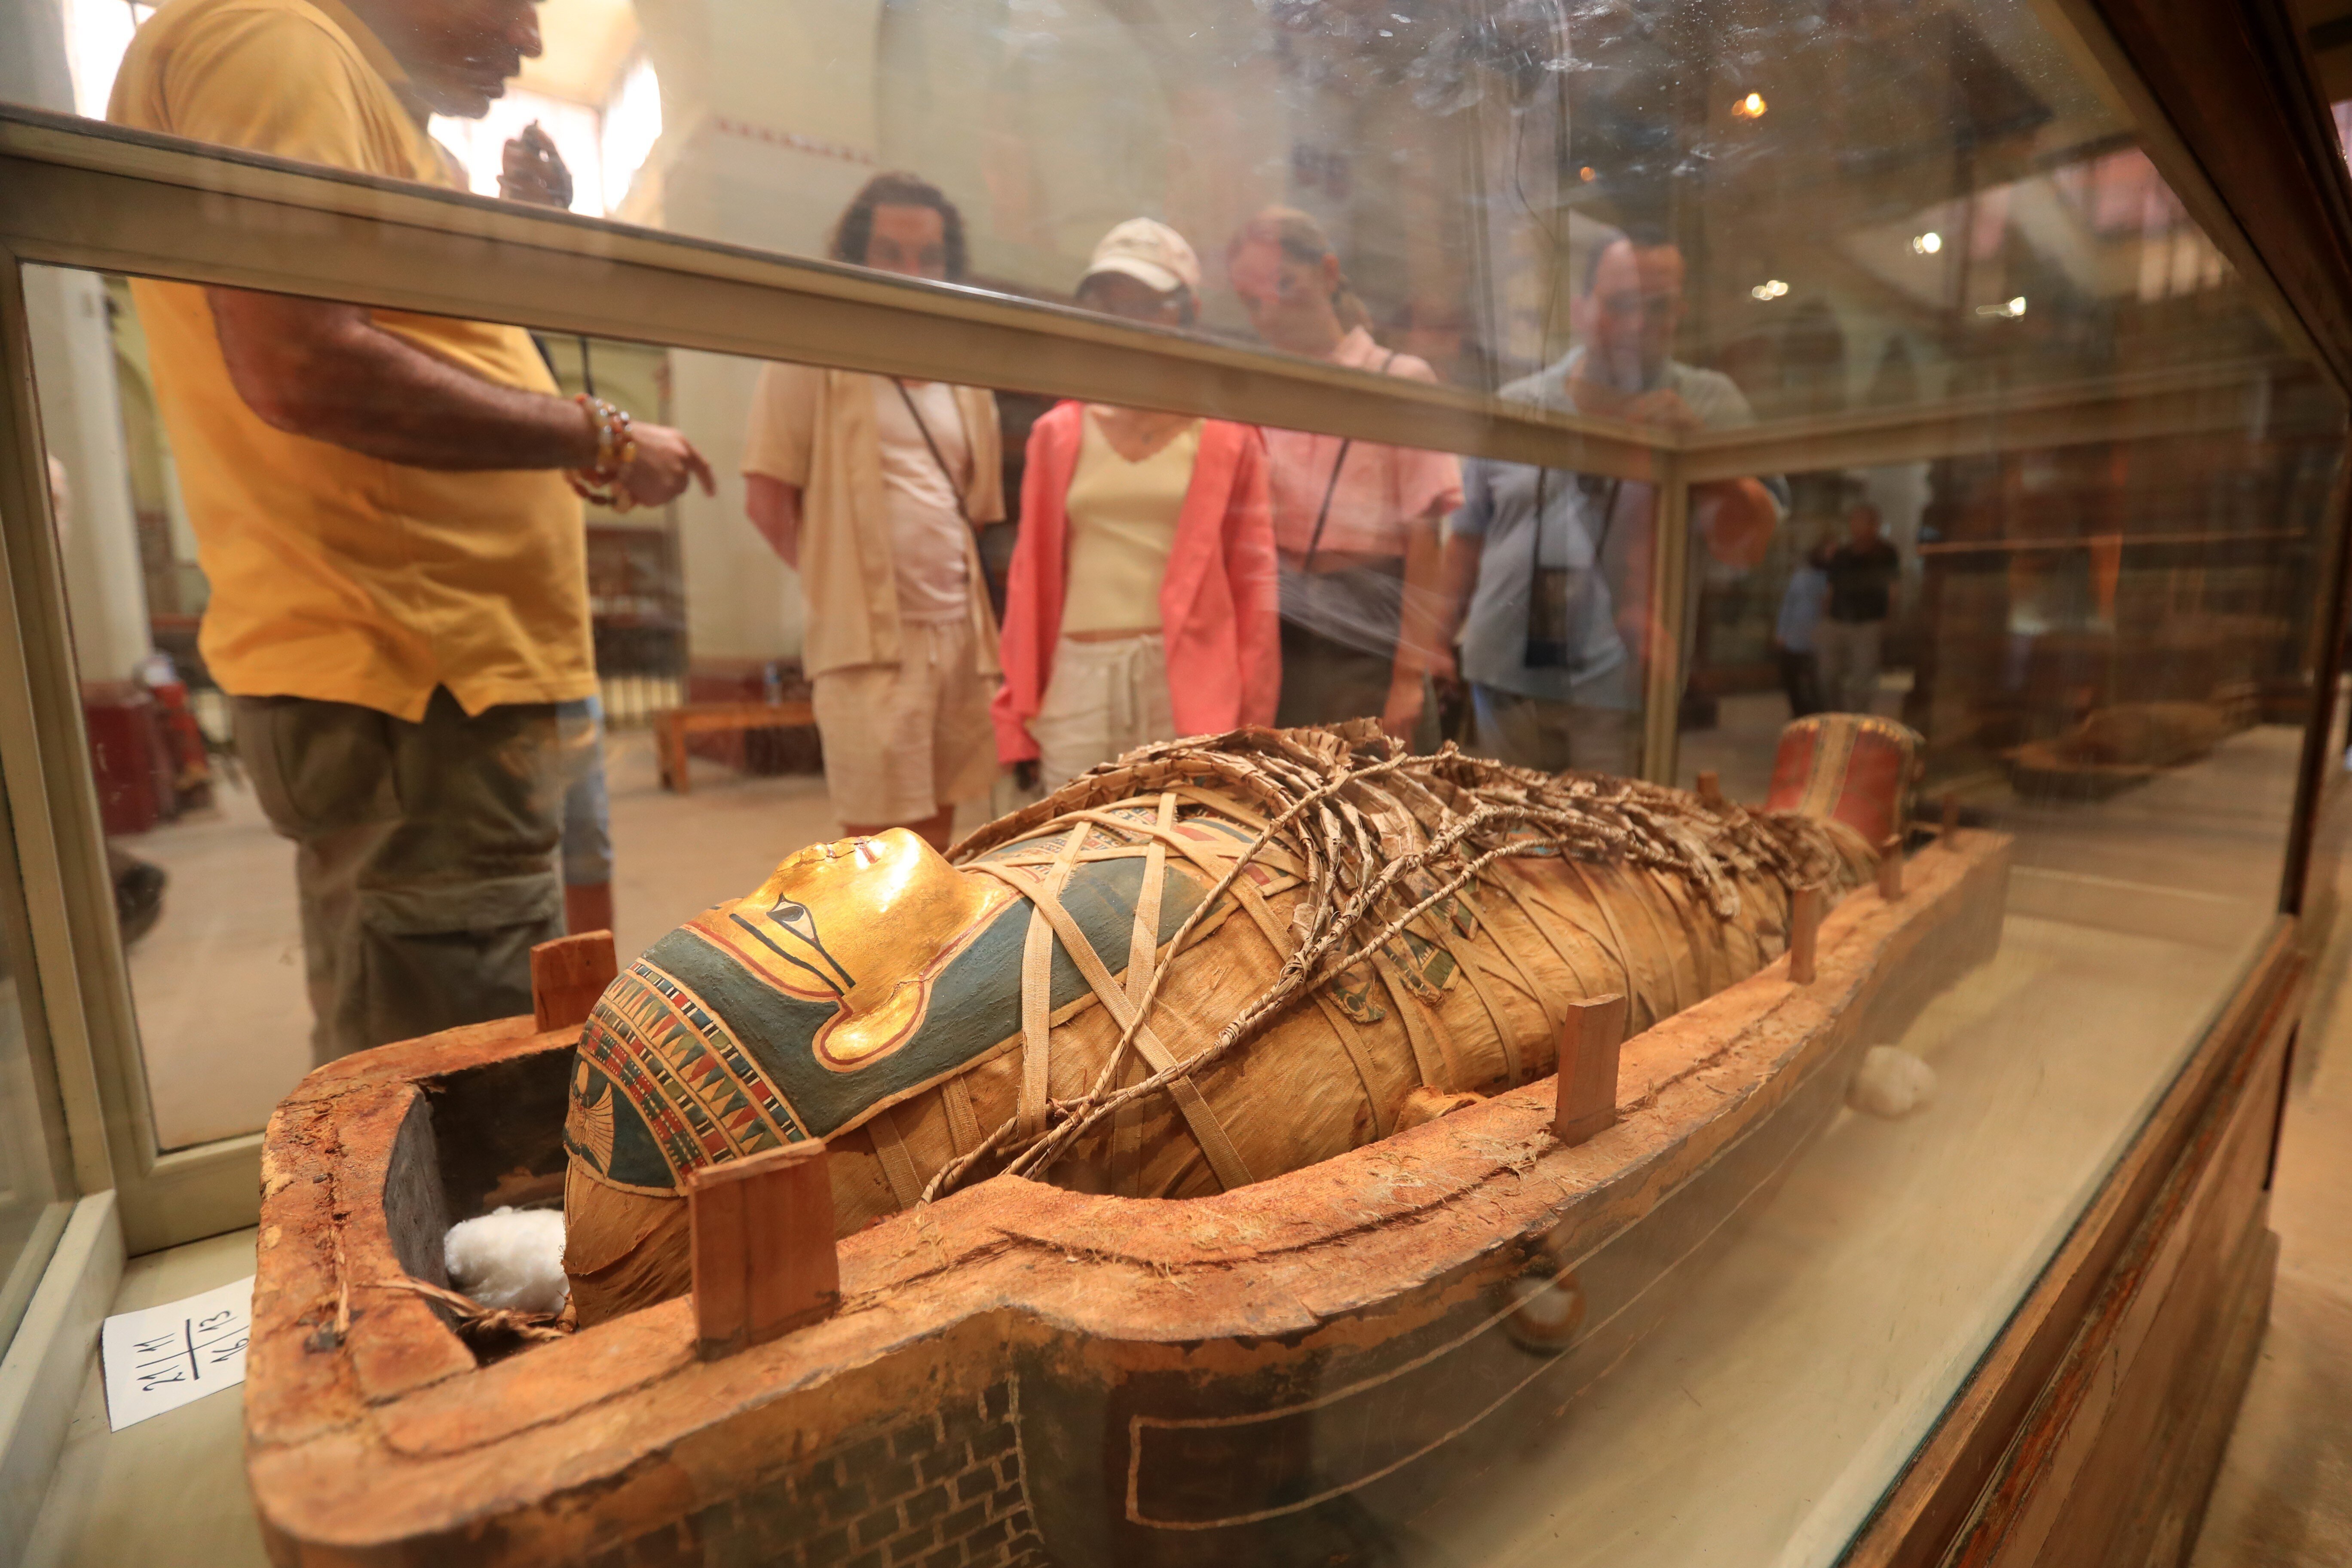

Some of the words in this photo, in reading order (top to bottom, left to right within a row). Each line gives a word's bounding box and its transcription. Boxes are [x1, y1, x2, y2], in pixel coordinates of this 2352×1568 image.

[197, 1310, 239, 1333] 13
[132, 1332, 176, 1353] 11
[210, 1338, 249, 1364] 16
[136, 1365, 186, 1391] 21
